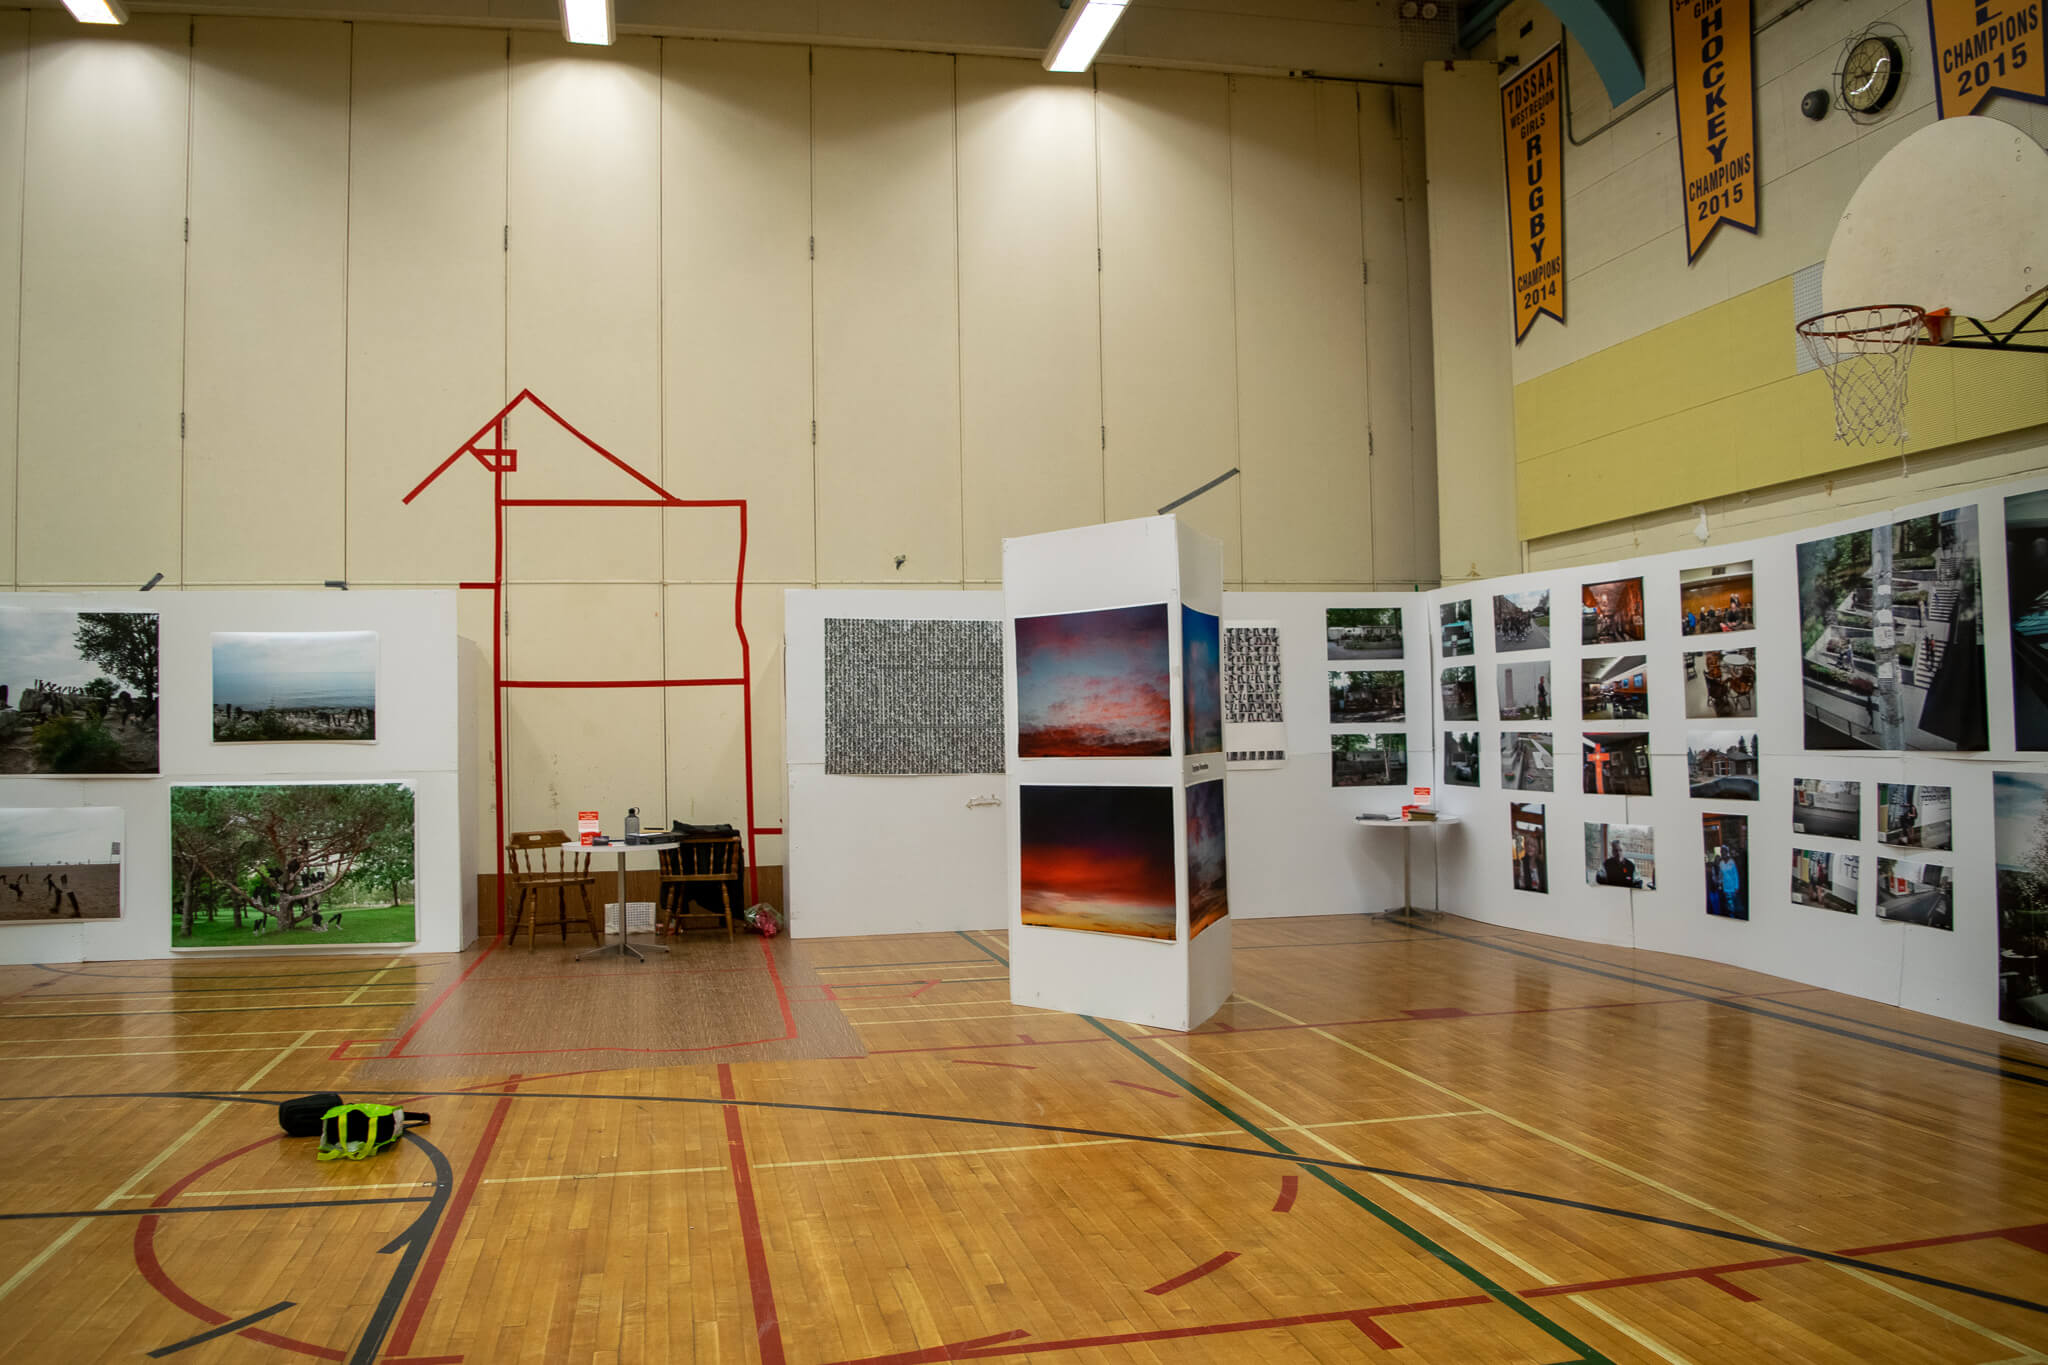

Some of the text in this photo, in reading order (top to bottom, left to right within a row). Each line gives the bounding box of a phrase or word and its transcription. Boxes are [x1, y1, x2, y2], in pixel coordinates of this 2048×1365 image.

[1943, 3, 2038, 74] CHAMPIONS
[1701, 8, 1728, 165] HOCKEY
[1957, 42, 2027, 97] 2015
[1521, 112, 1546, 139] GIRLS
[1526, 134, 1546, 263] RUGBY
[1689, 152, 1751, 202] CHAMPIONS
[1697, 182, 1744, 221] 2015
[1517, 255, 1561, 293] CHAMPIONS
[1523, 280, 1557, 309] 2014
